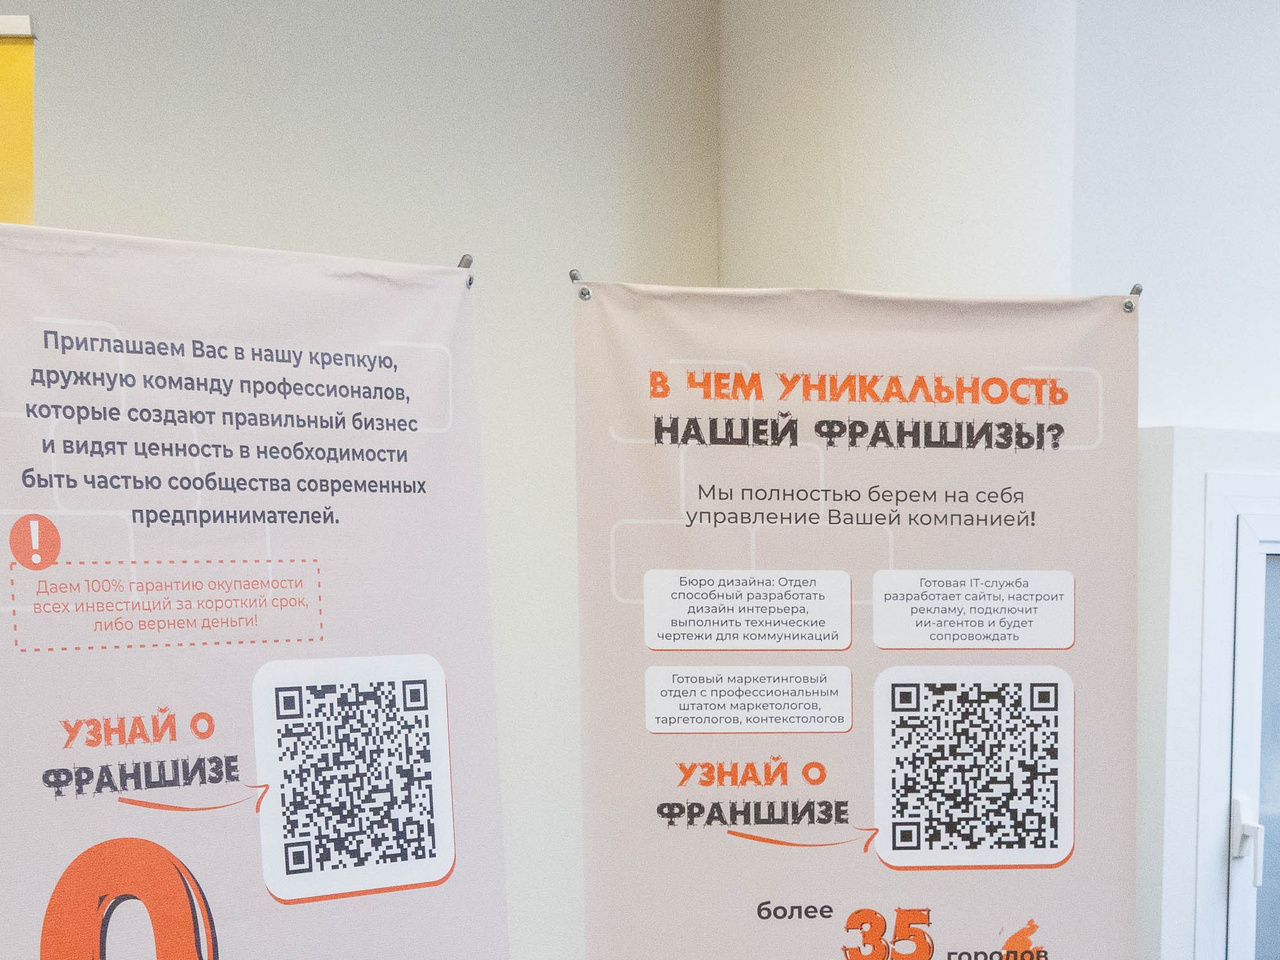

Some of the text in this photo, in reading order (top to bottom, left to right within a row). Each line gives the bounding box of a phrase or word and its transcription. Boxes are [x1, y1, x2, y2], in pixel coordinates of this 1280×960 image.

[42, 329, 398, 373] Приглашаем Вас в нашу крепкую,
[30, 367, 410, 405] дружную команду профессионалов,
[649, 370, 1069, 406] В ЧЕМ УНИКАЛЬНОСТЬ
[653, 412, 1065, 450] НАШЕЙ ФРАНШИЗЫ?
[698, 483, 1024, 506] Мы полностью берем на себя
[131, 505, 340, 528] предпринимателей.
[684, 508, 1036, 528] управление Вашей компанией!
[35, 578, 303, 596] Даем 100% гарантию окупаемости
[678, 575, 817, 589] Бюро дизайна: Отдел
[670, 588, 826, 603] способный разработать
[686, 603, 809, 616] дизайн интерьера,
[92, 613, 258, 633] либо вернем деньги!
[670, 618, 826, 628] выполнить технические
[656, 630, 839, 643] чертежи для коммуникаций
[671, 673, 827, 686] Готовый маркетинговый
[659, 686, 839, 699] отдел с профессиональным
[678, 701, 822, 713] штатом маркетологов,
[60, 707, 215, 749] УЗНАЙ О
[654, 714, 845, 727] таргетологов, контекстологов
[42, 755, 240, 801] ФРАНШИЗЕ
[675, 755, 827, 787] УЗНАЙ О
[656, 800, 849, 828] ФРАНШИЗЕ
[756, 899, 834, 920] более
